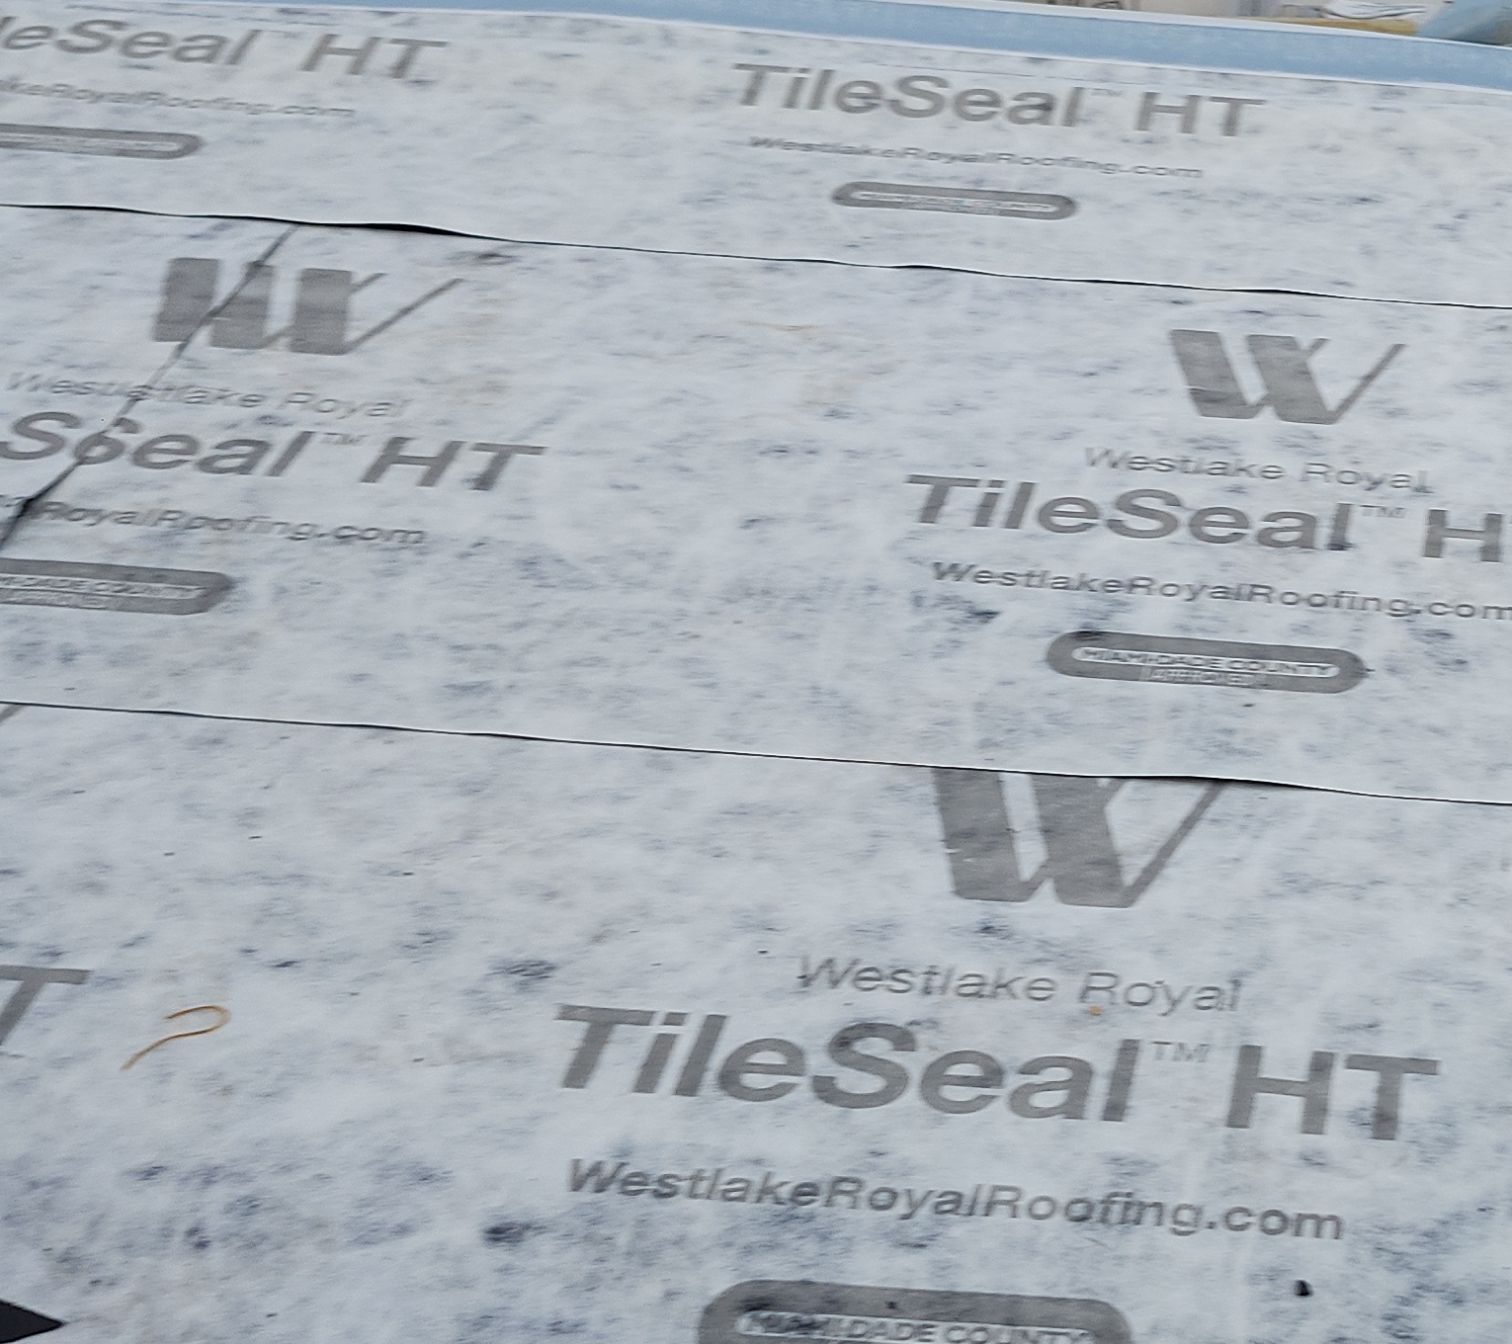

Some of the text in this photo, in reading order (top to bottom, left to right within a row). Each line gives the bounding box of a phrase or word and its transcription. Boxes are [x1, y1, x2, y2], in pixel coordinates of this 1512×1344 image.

[301, 33, 448, 79] HT
[1135, 92, 1267, 137] HT
[361, 437, 546, 491] HT
[1085, 446, 1435, 494] Westlake Royal
[799, 953, 1242, 1014] Westlake Royal
[1227, 1043, 1439, 1141] HT
[567, 1158, 1344, 1240] WestlakeRoyalRoofing.com
